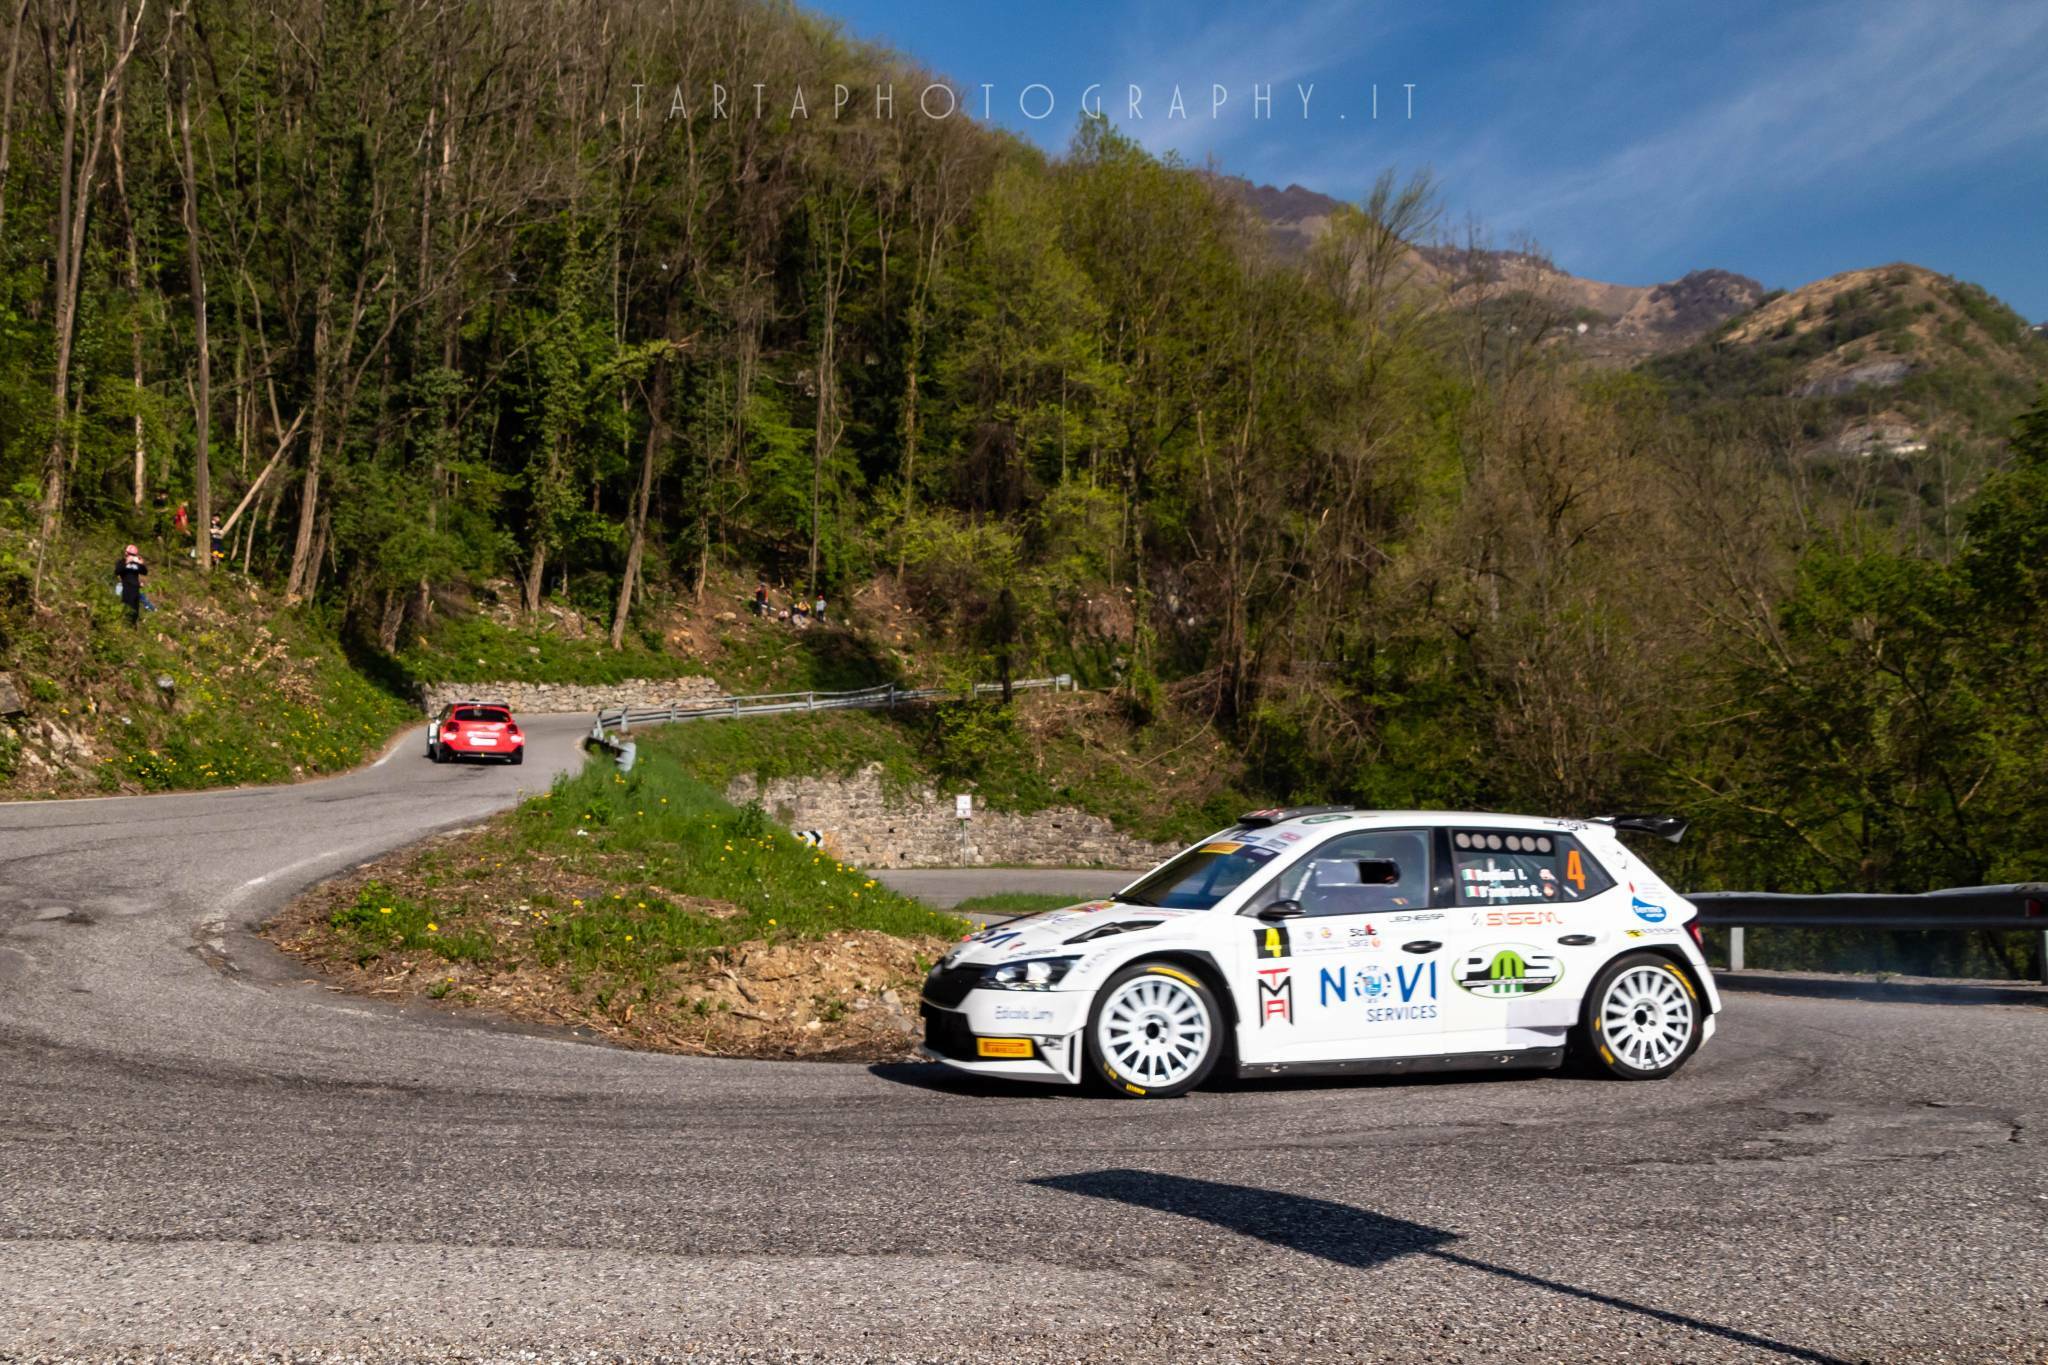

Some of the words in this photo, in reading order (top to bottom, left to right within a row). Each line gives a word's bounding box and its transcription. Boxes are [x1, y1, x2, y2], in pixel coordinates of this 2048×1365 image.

[1567, 850, 1586, 890] 4
[1264, 927, 1282, 958] 4
[1320, 960, 1437, 1007] NOVI
[1367, 1005, 1437, 1022] SERVICES
